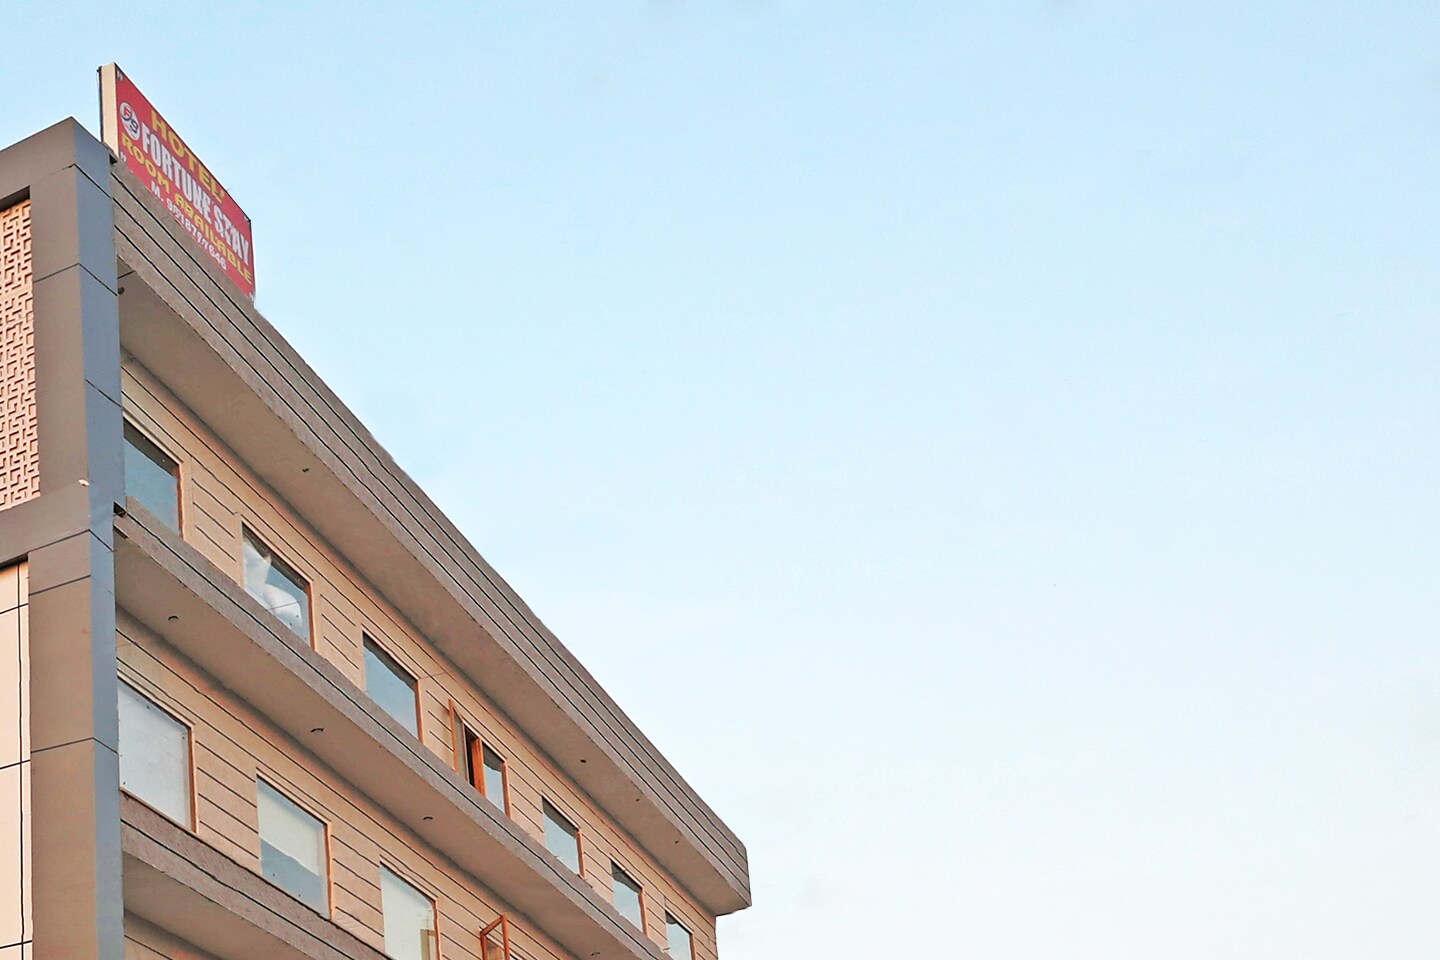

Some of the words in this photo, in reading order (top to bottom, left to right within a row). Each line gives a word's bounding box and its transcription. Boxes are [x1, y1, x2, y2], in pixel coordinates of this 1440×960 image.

[121, 131, 170, 194] ROOM
[142, 122, 213, 224] FORTUNE
[214, 204, 250, 266] STAY
[152, 109, 225, 203] HOTEL
